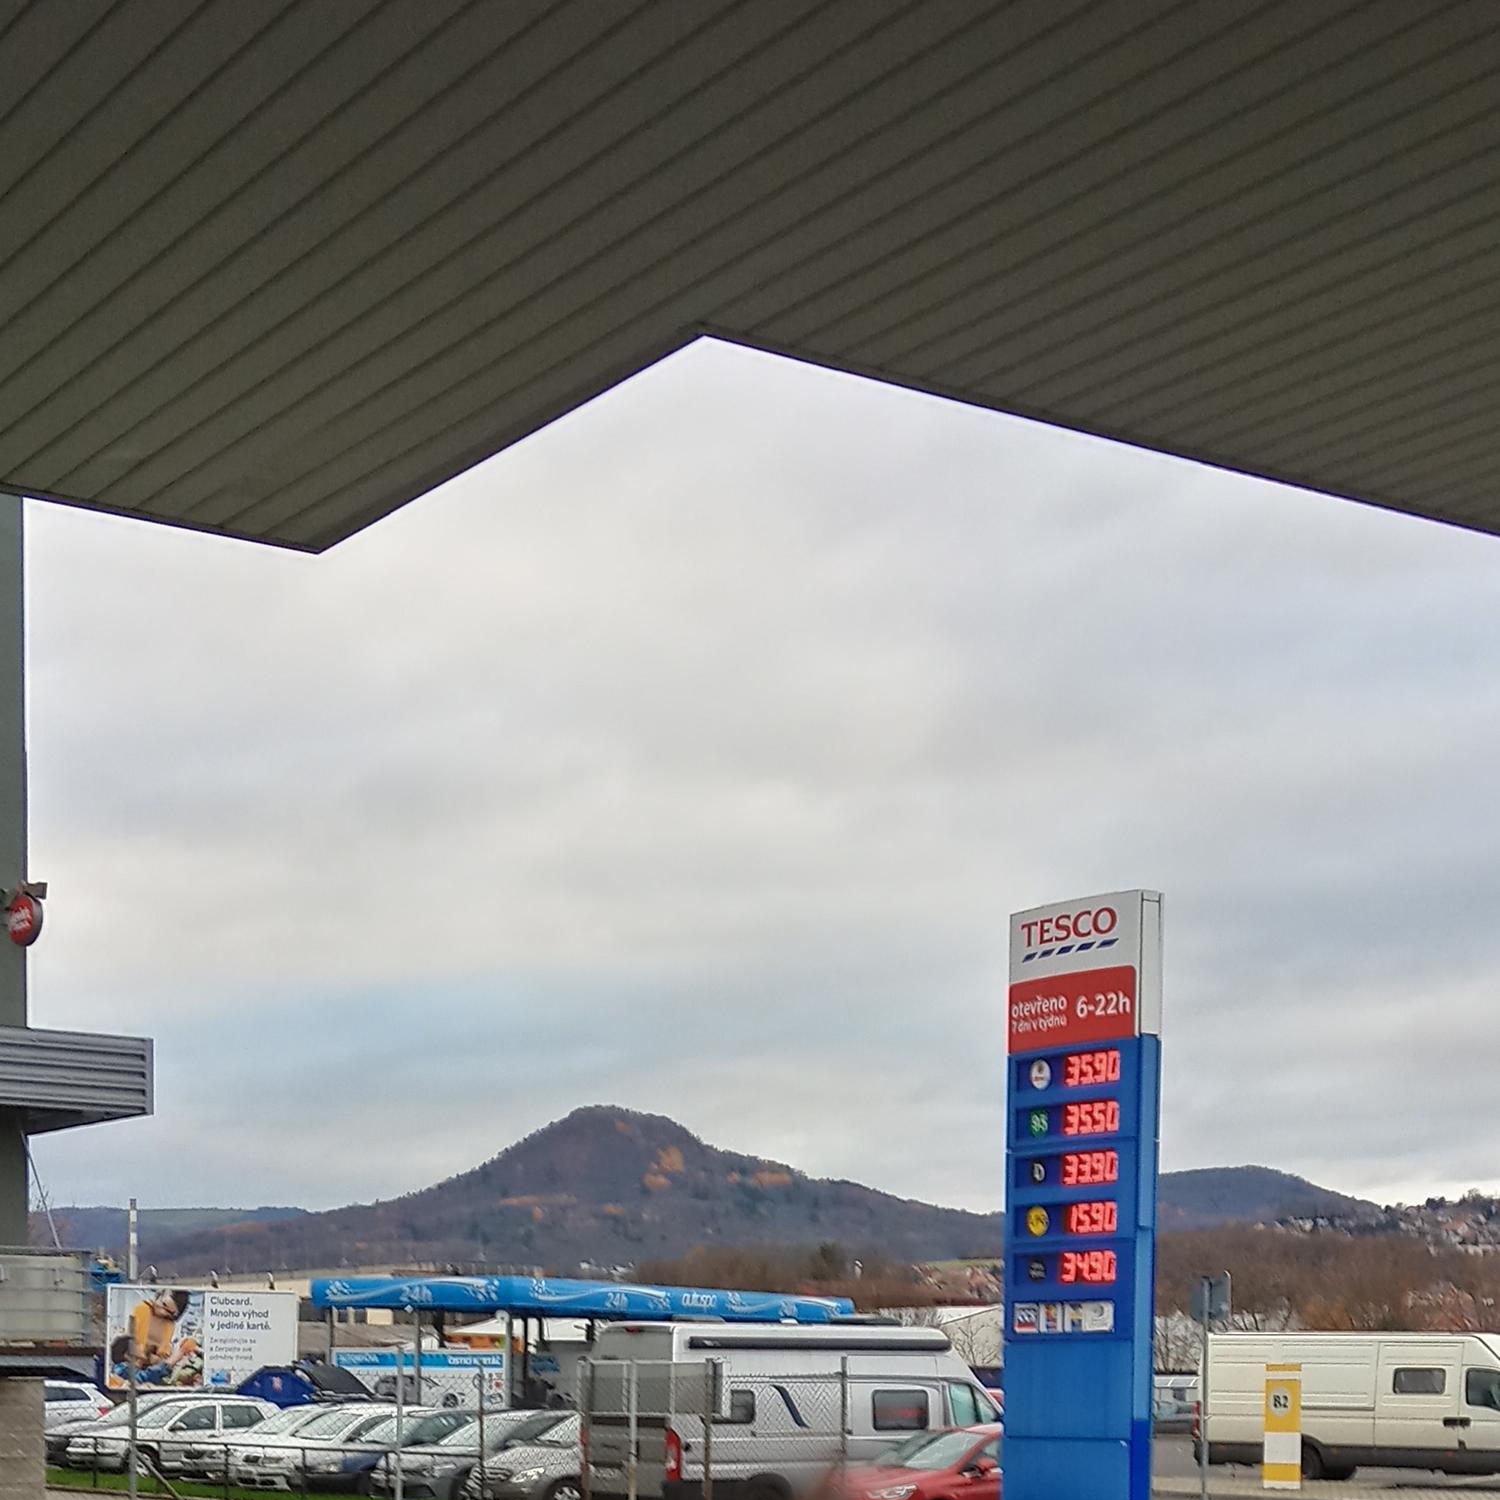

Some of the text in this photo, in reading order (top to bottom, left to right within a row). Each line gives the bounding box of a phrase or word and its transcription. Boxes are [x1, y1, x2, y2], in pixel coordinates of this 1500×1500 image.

[1021, 907, 1117, 948] TESCO
[1012, 990, 1130, 1018] otevřeno 6-22h
[1033, 1163, 1045, 1181] D
[210, 1297, 253, 1305] Clubcard.
[400, 1285, 432, 1303] 24h
[210, 1309, 269, 1319] Mnoho výhod
